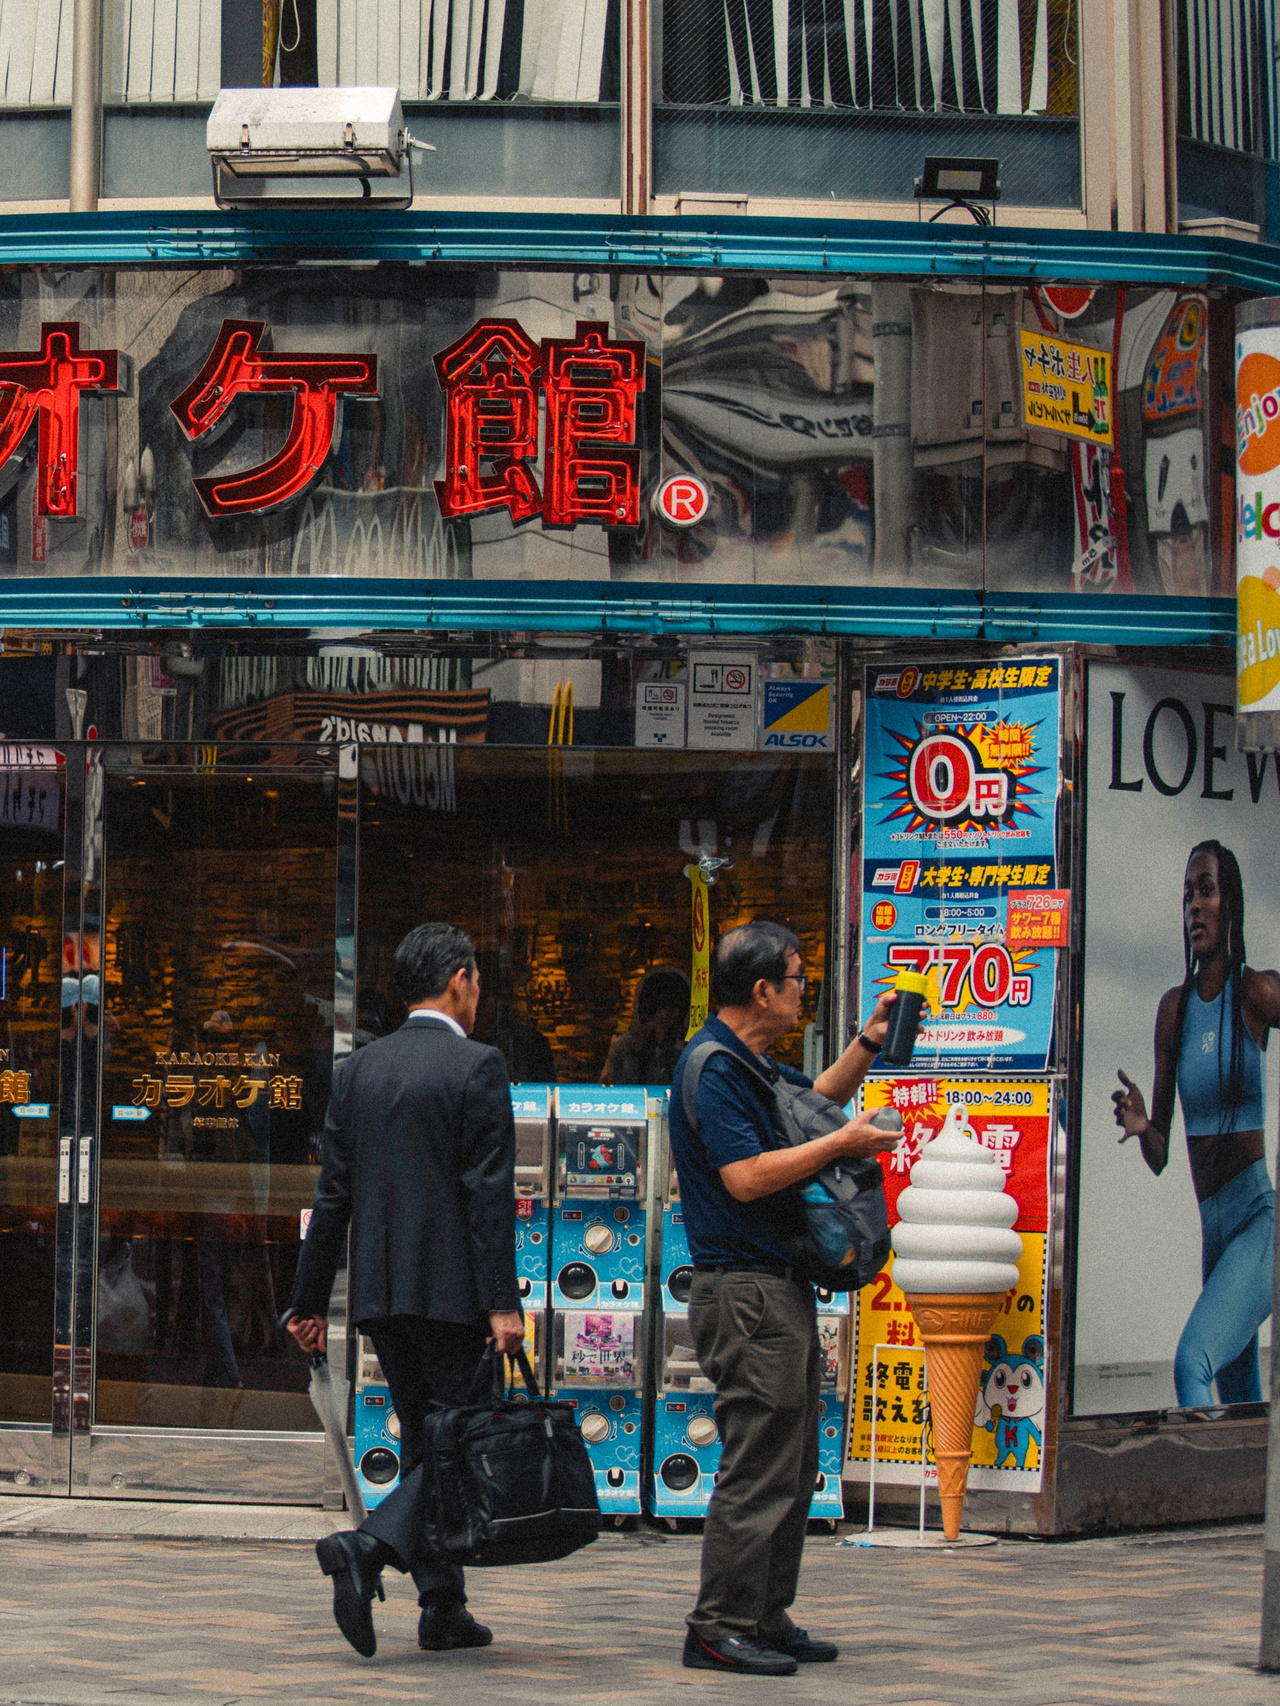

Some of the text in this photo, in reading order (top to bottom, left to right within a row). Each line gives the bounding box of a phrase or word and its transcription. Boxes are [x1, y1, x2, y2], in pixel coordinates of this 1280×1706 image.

[1237, 390, 1280, 460] Enjo
[1238, 492, 1280, 543] elc
[1256, 619, 1280, 661] Lov
[922, 666, 1053, 692] 中学生・高校生限定
[765, 733, 828, 748] ALSOK
[913, 735, 1008, 819] 0円
[920, 865, 1051, 888] 大学生・専門学生限定
[1011, 911, 1061, 926] サワー7種
[918, 1029, 1004, 1043] フトドリンク飲み放題
[155, 1051, 281, 1067] KARAOKE KAN
[131, 1074, 303, 1110] カラオケ館
[568, 1102, 636, 1114] カラオケ館
[890, 1121, 1021, 1176] 終電
